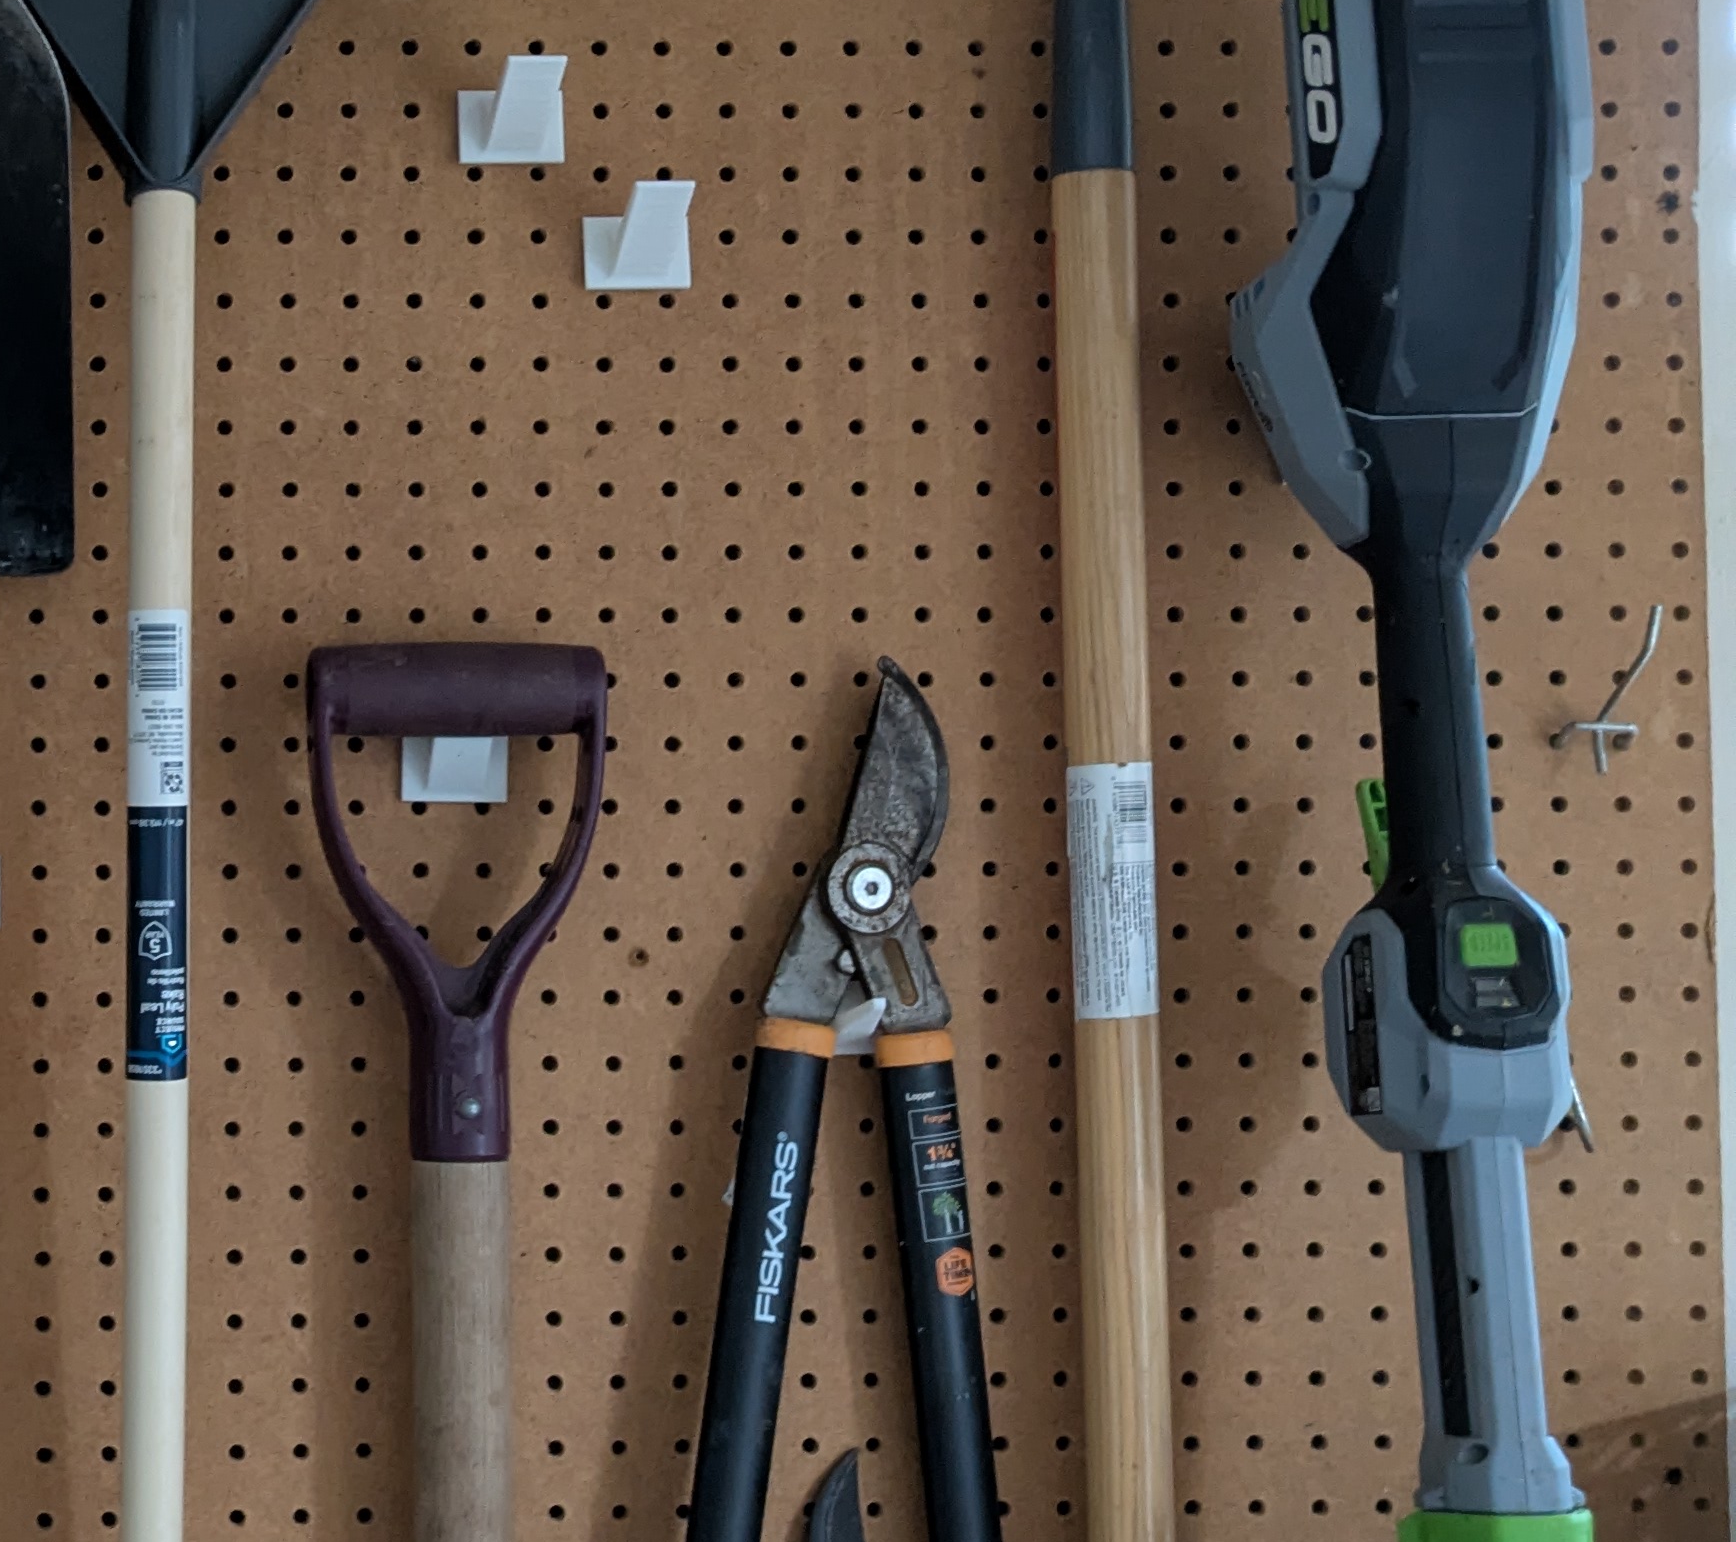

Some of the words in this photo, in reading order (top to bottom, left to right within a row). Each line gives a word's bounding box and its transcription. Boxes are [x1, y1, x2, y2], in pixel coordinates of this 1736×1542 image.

[149, 938, 161, 953] 5
[140, 1001, 164, 1014] Leaf
[905, 1091, 936, 1102] Lopper
